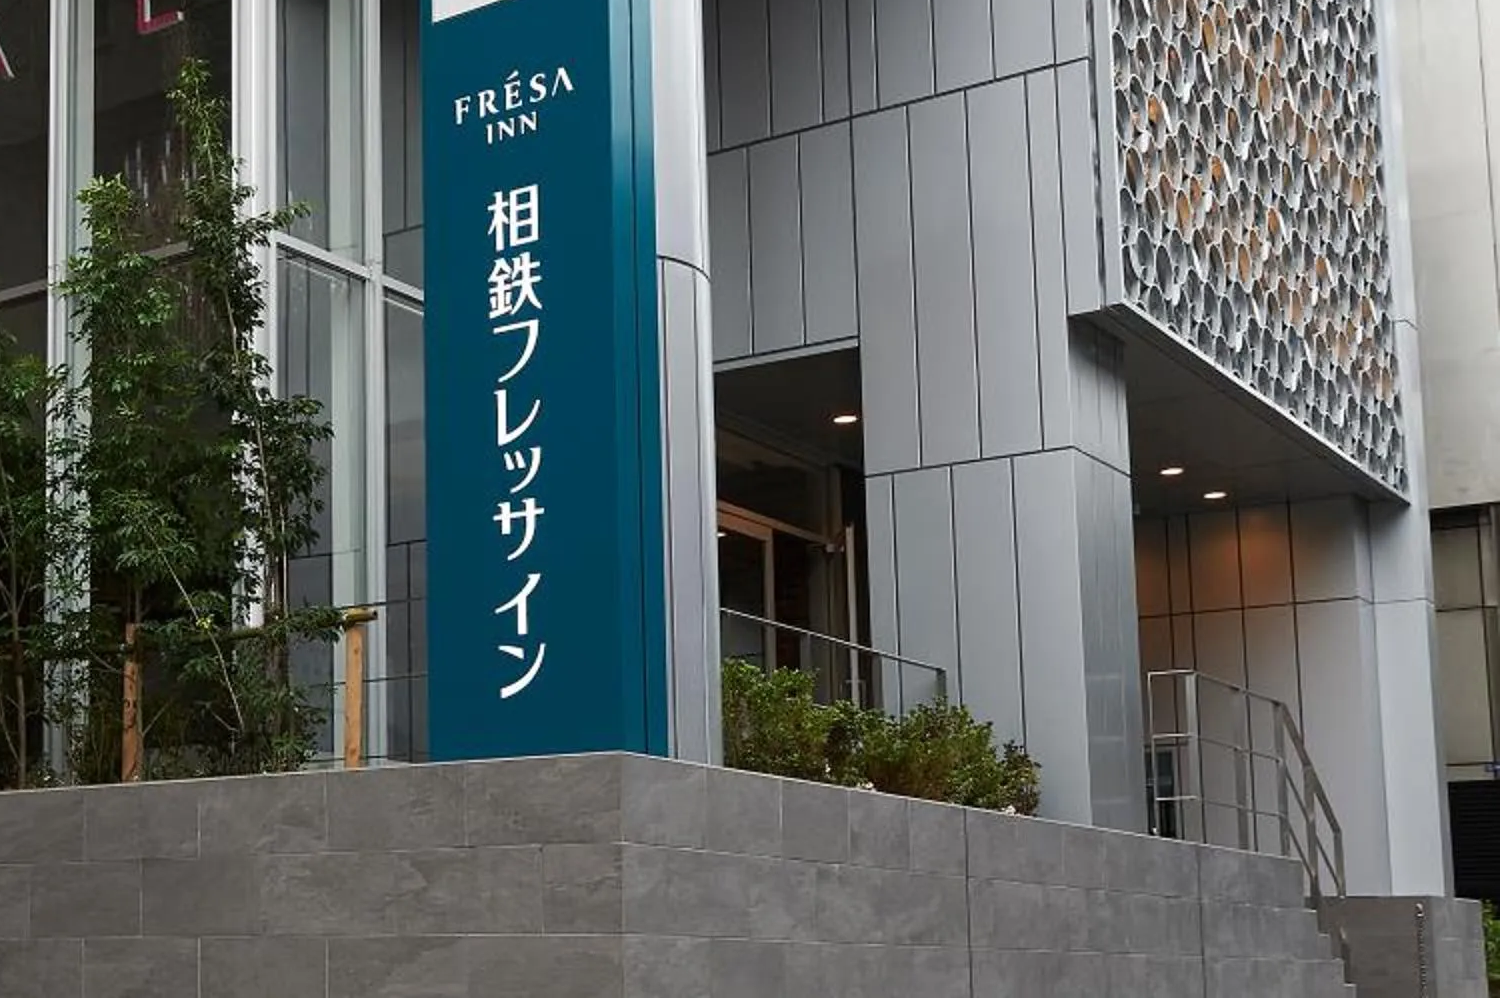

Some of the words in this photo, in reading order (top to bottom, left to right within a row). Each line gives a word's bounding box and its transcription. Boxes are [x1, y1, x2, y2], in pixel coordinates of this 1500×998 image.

[486, 111, 539, 145] INN
[487, 184, 547, 699] 相鉄フレッサイン
